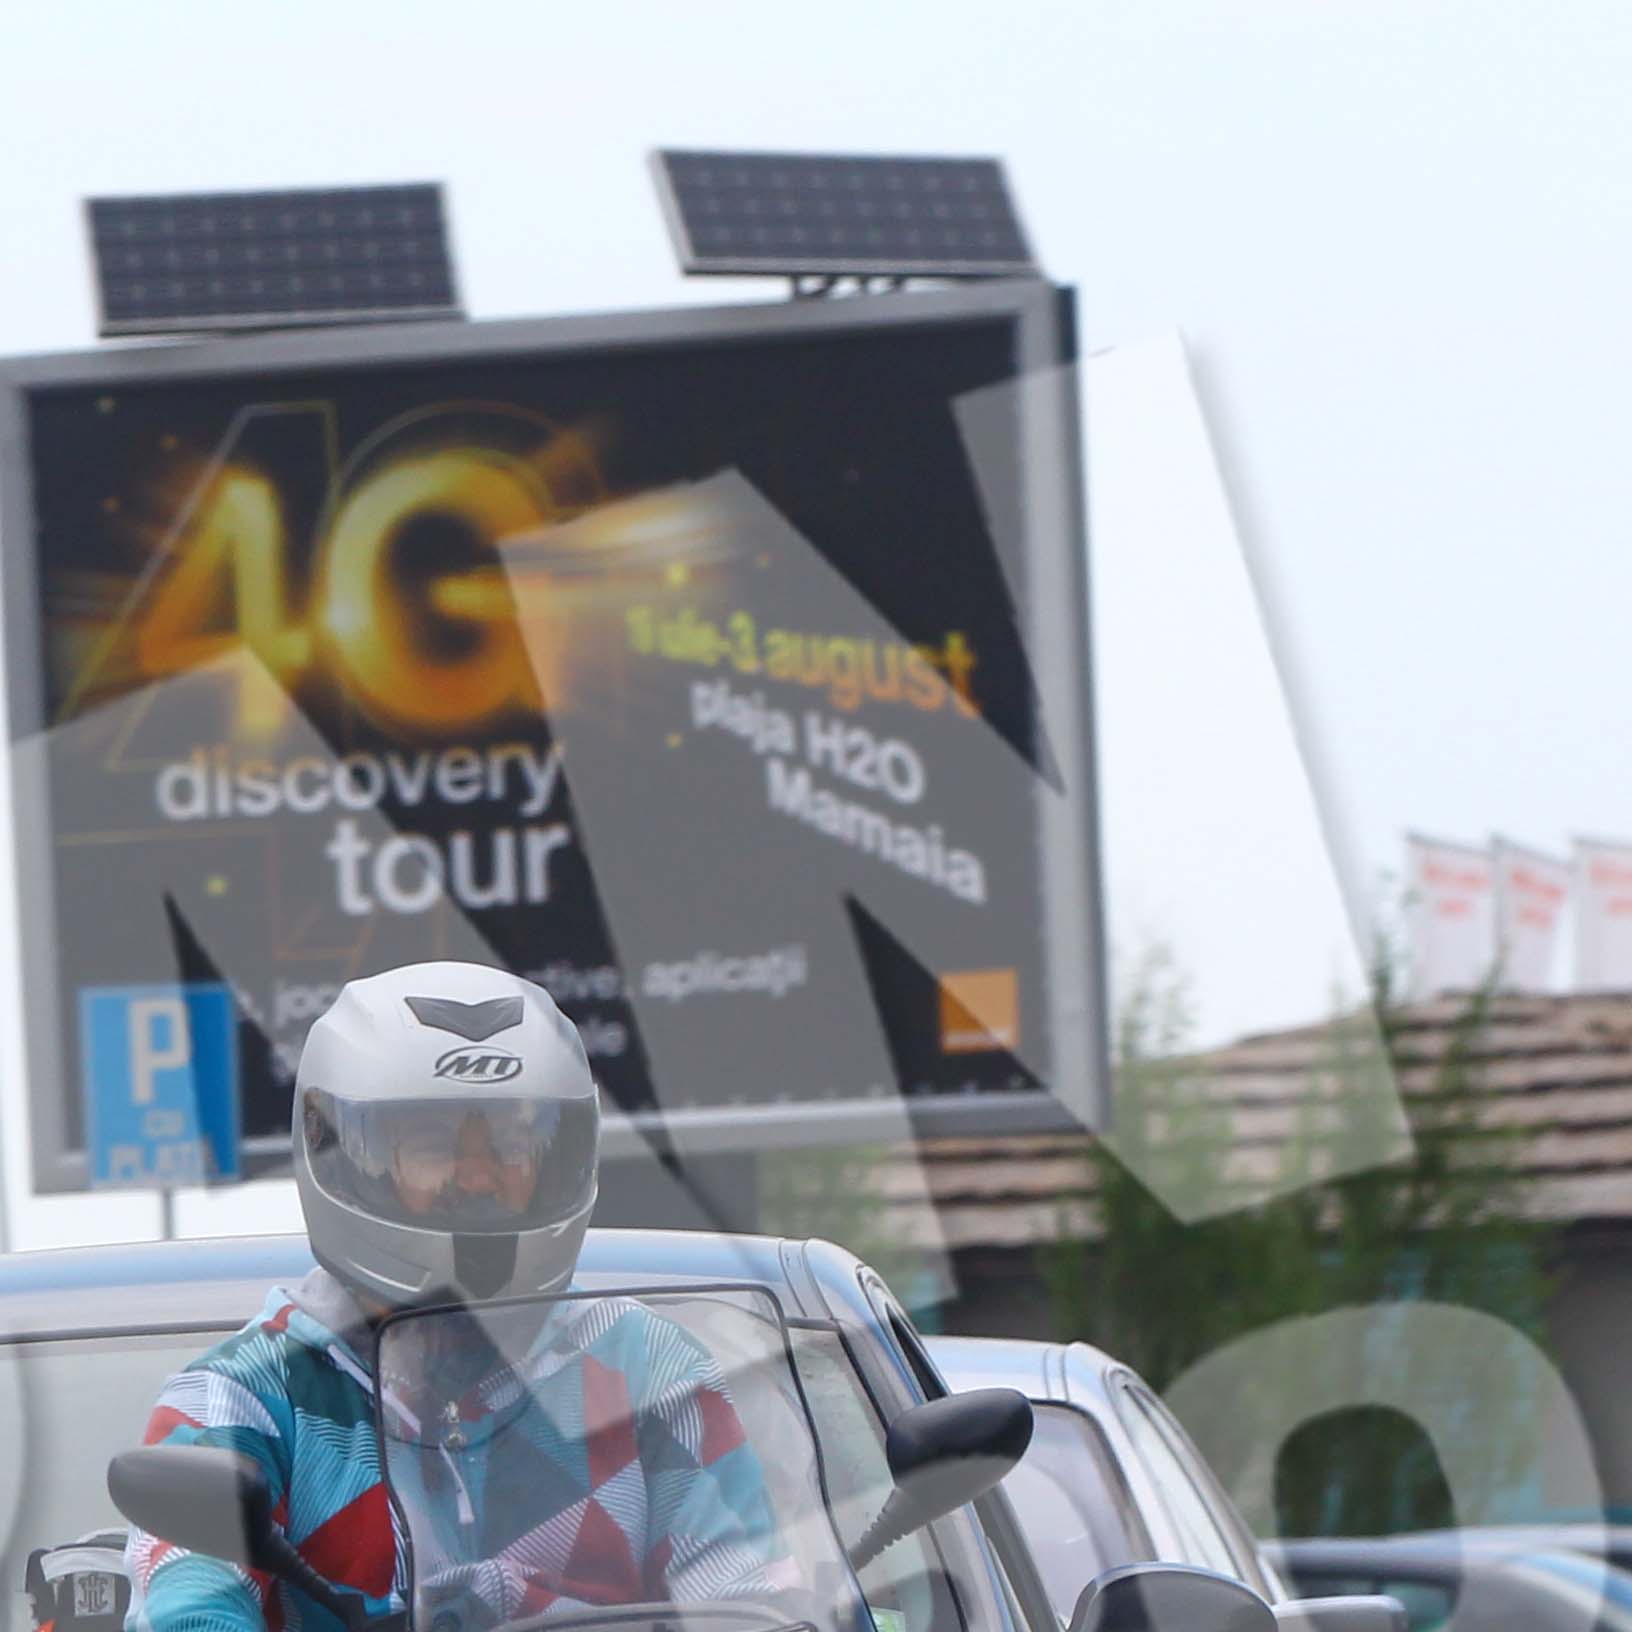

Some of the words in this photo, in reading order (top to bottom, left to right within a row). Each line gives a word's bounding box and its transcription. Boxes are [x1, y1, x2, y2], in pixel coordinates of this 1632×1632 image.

[133, 448, 564, 738] 4G
[764, 630, 979, 720] august
[154, 738, 566, 820] discovery
[690, 678, 794, 755] plaja
[803, 710, 926, 804] H2O
[328, 820, 570, 916] tour
[766, 756, 986, 904] Mamaia
[128, 998, 193, 1104] P
